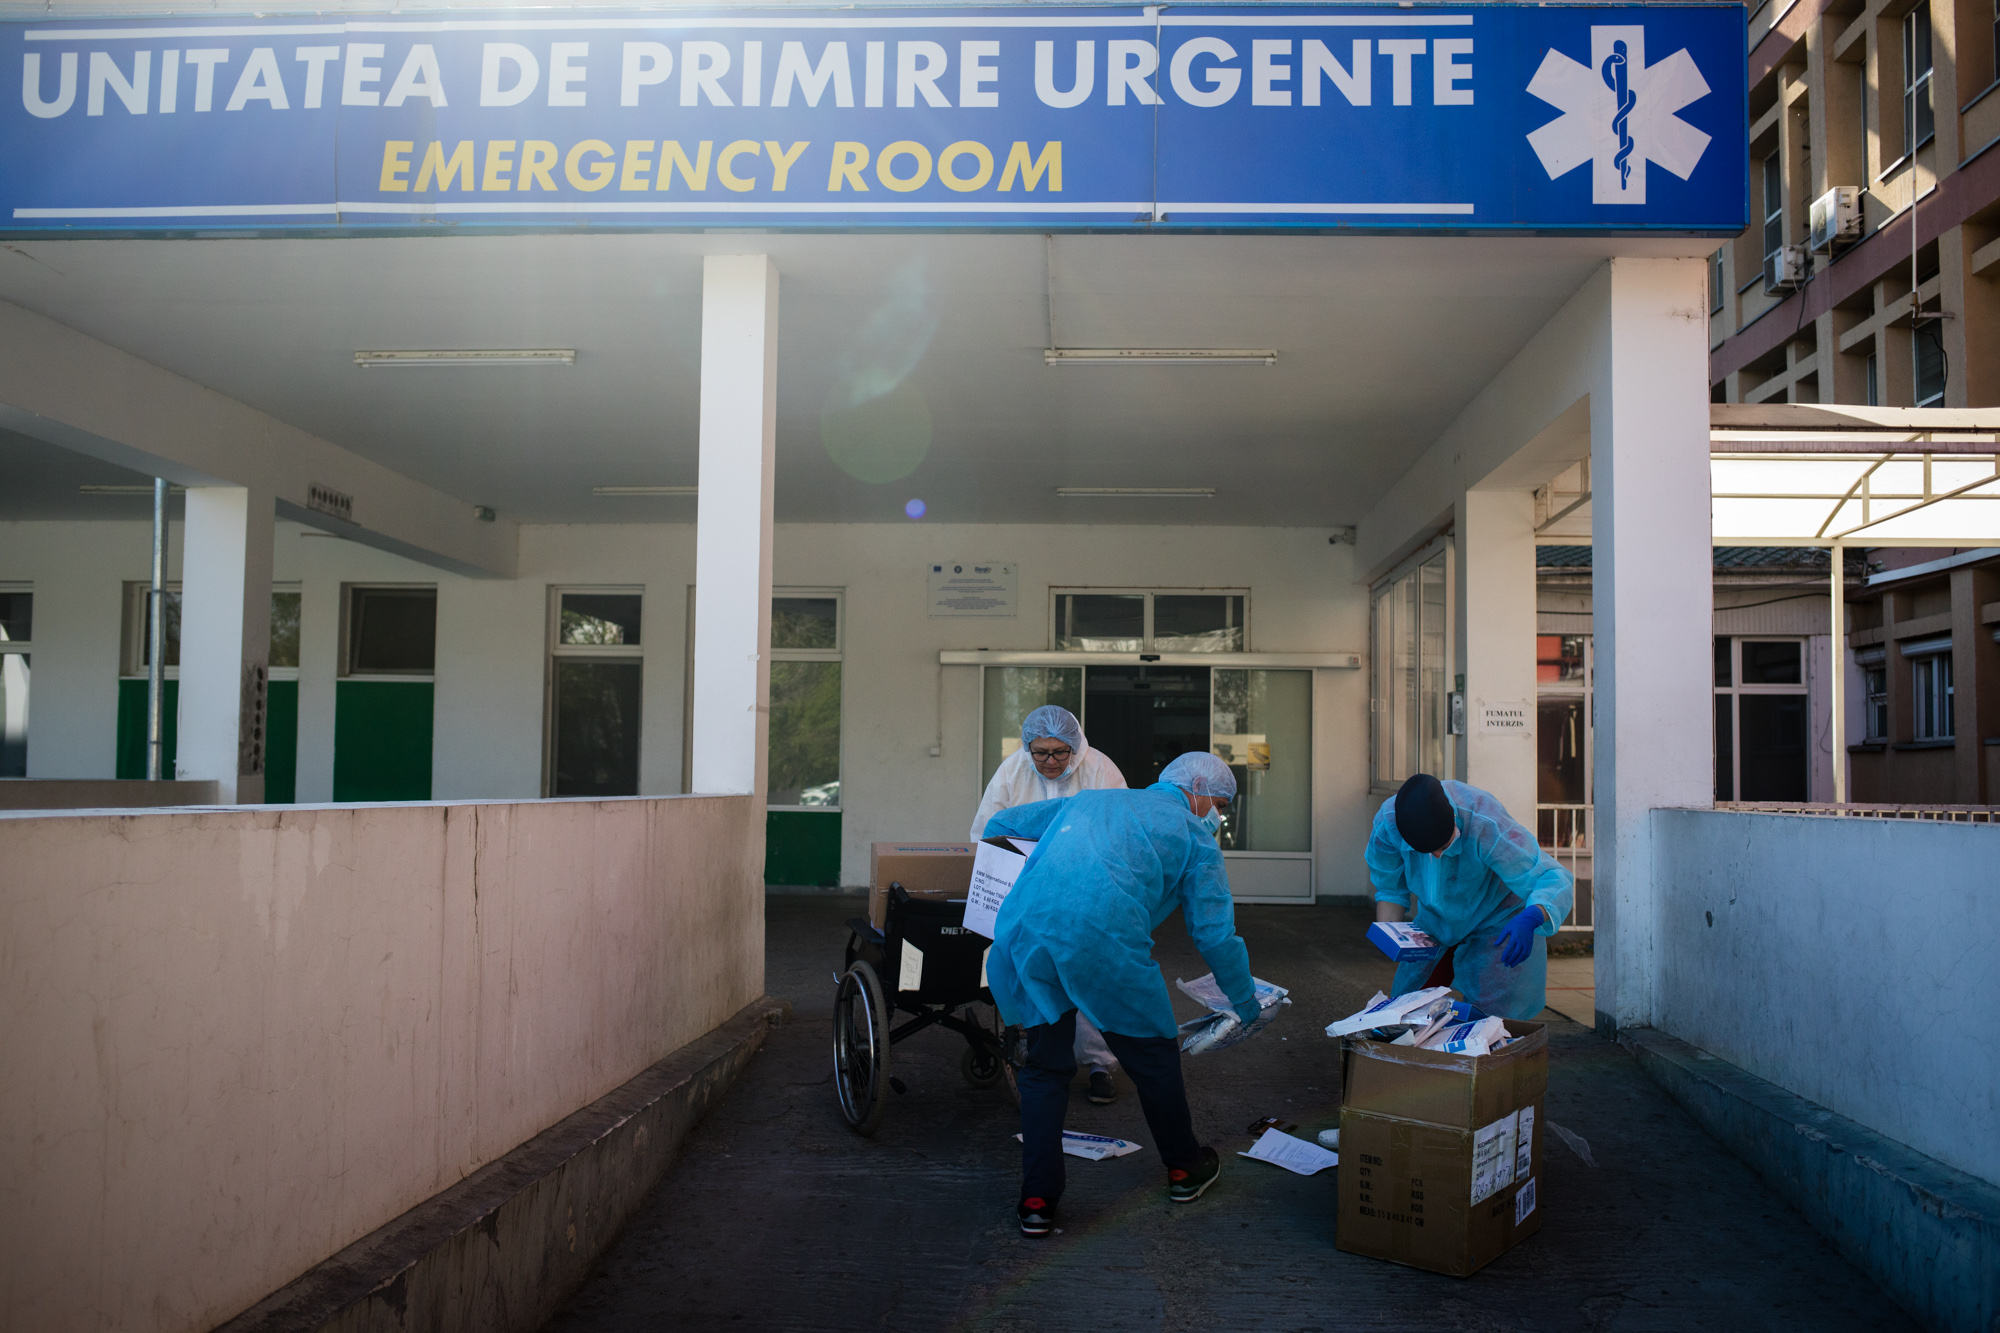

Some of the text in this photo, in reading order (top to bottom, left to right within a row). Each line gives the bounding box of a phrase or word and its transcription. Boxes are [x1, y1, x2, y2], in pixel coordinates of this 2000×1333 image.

[21, 37, 1474, 118] UNITATEA DE PRIMIRE URGENTE
[378, 139, 1063, 192] EMERGENCY ROOM
[986, 873, 1007, 885] International
[982, 887, 995, 896] Number
[1412, 1178, 1422, 1187] PCS
[1411, 1190, 1424, 1200] KGS
[1411, 1203, 1423, 1213] KGS
